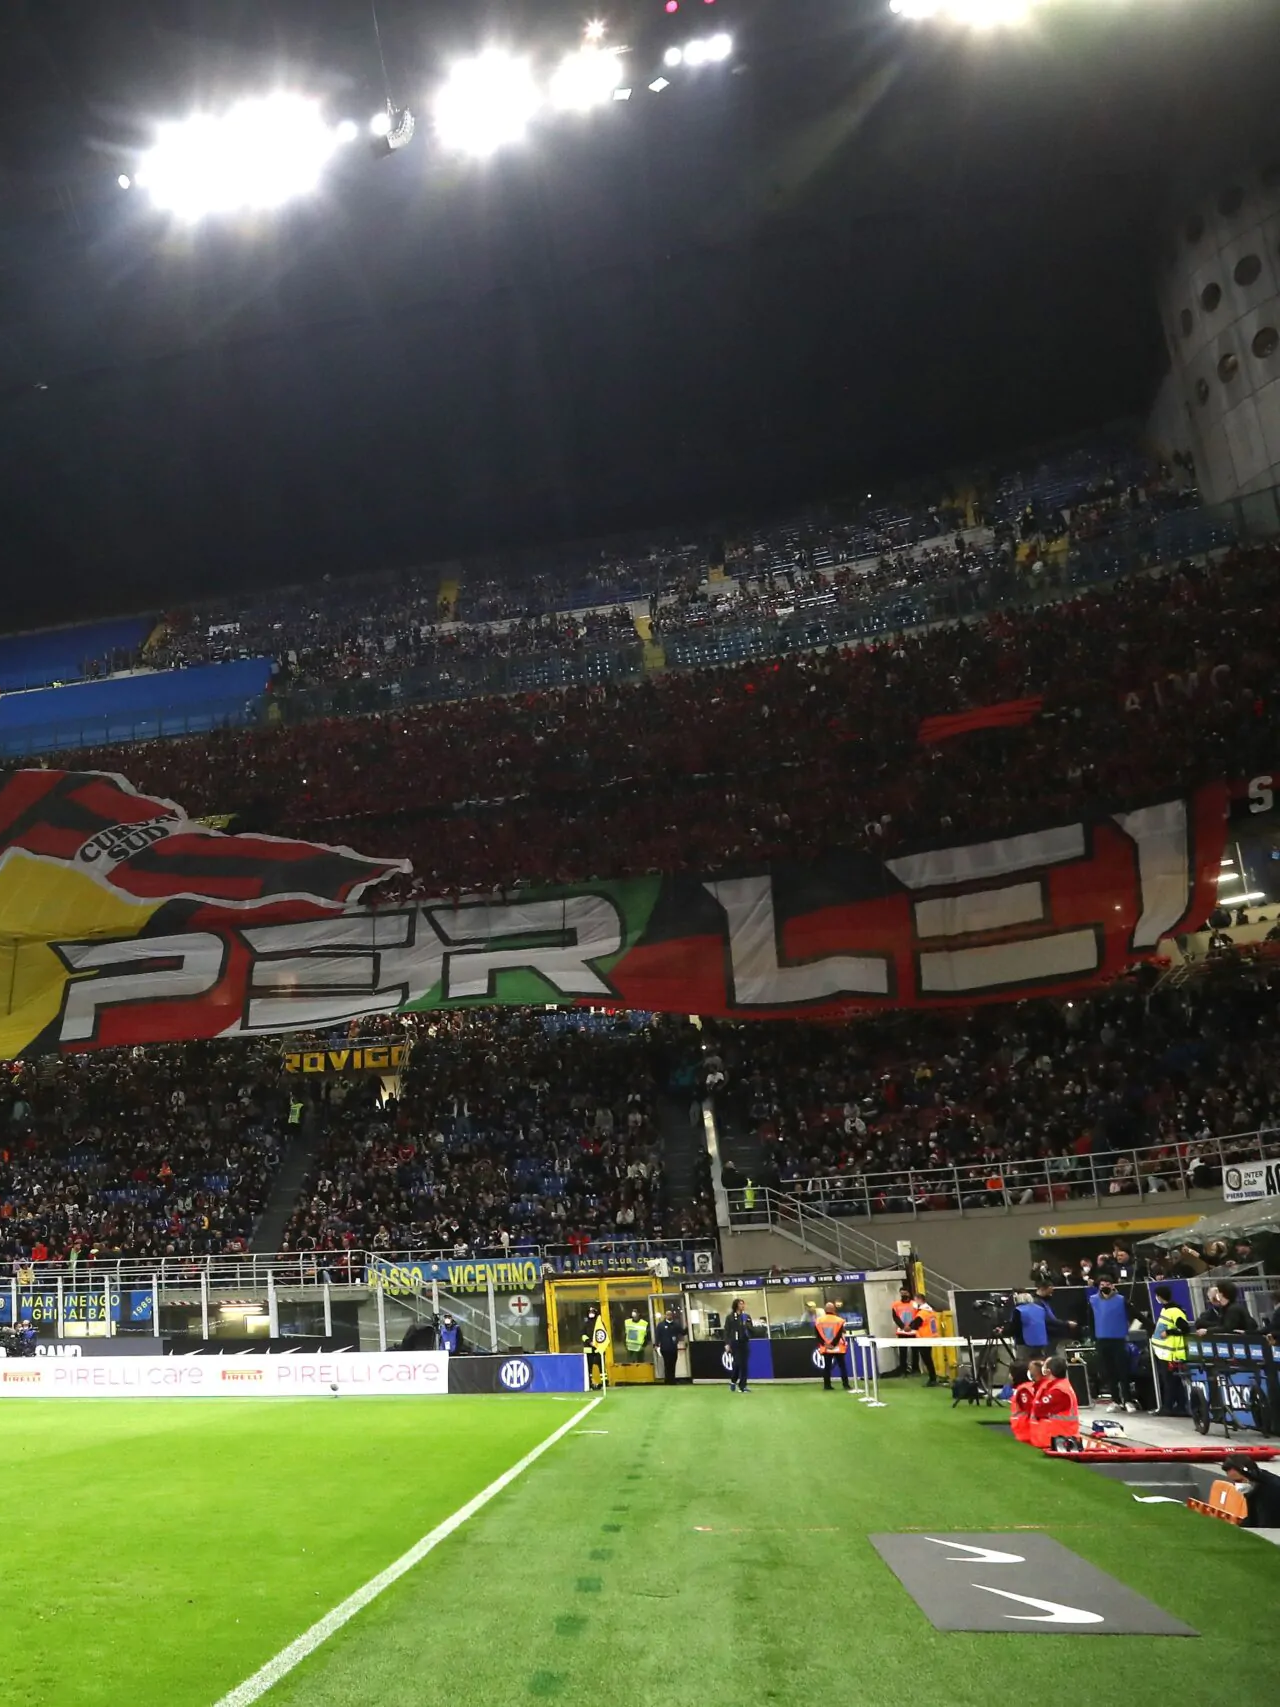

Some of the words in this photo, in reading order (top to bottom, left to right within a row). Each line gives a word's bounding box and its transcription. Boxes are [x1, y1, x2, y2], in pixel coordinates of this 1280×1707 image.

[107, 825, 170, 862] SUD
[58, 894, 618, 1042] PER
[577, 1257, 604, 1267] INTER
[608, 1257, 632, 1266] CLUB
[447, 1260, 537, 1293] VICENTINO
[3, 1371, 42, 1383] PIRELLI
[55, 1367, 142, 1386] PIRELLI
[221, 1369, 264, 1381] PIRELLI
[277, 1365, 371, 1384] PIRELLI
